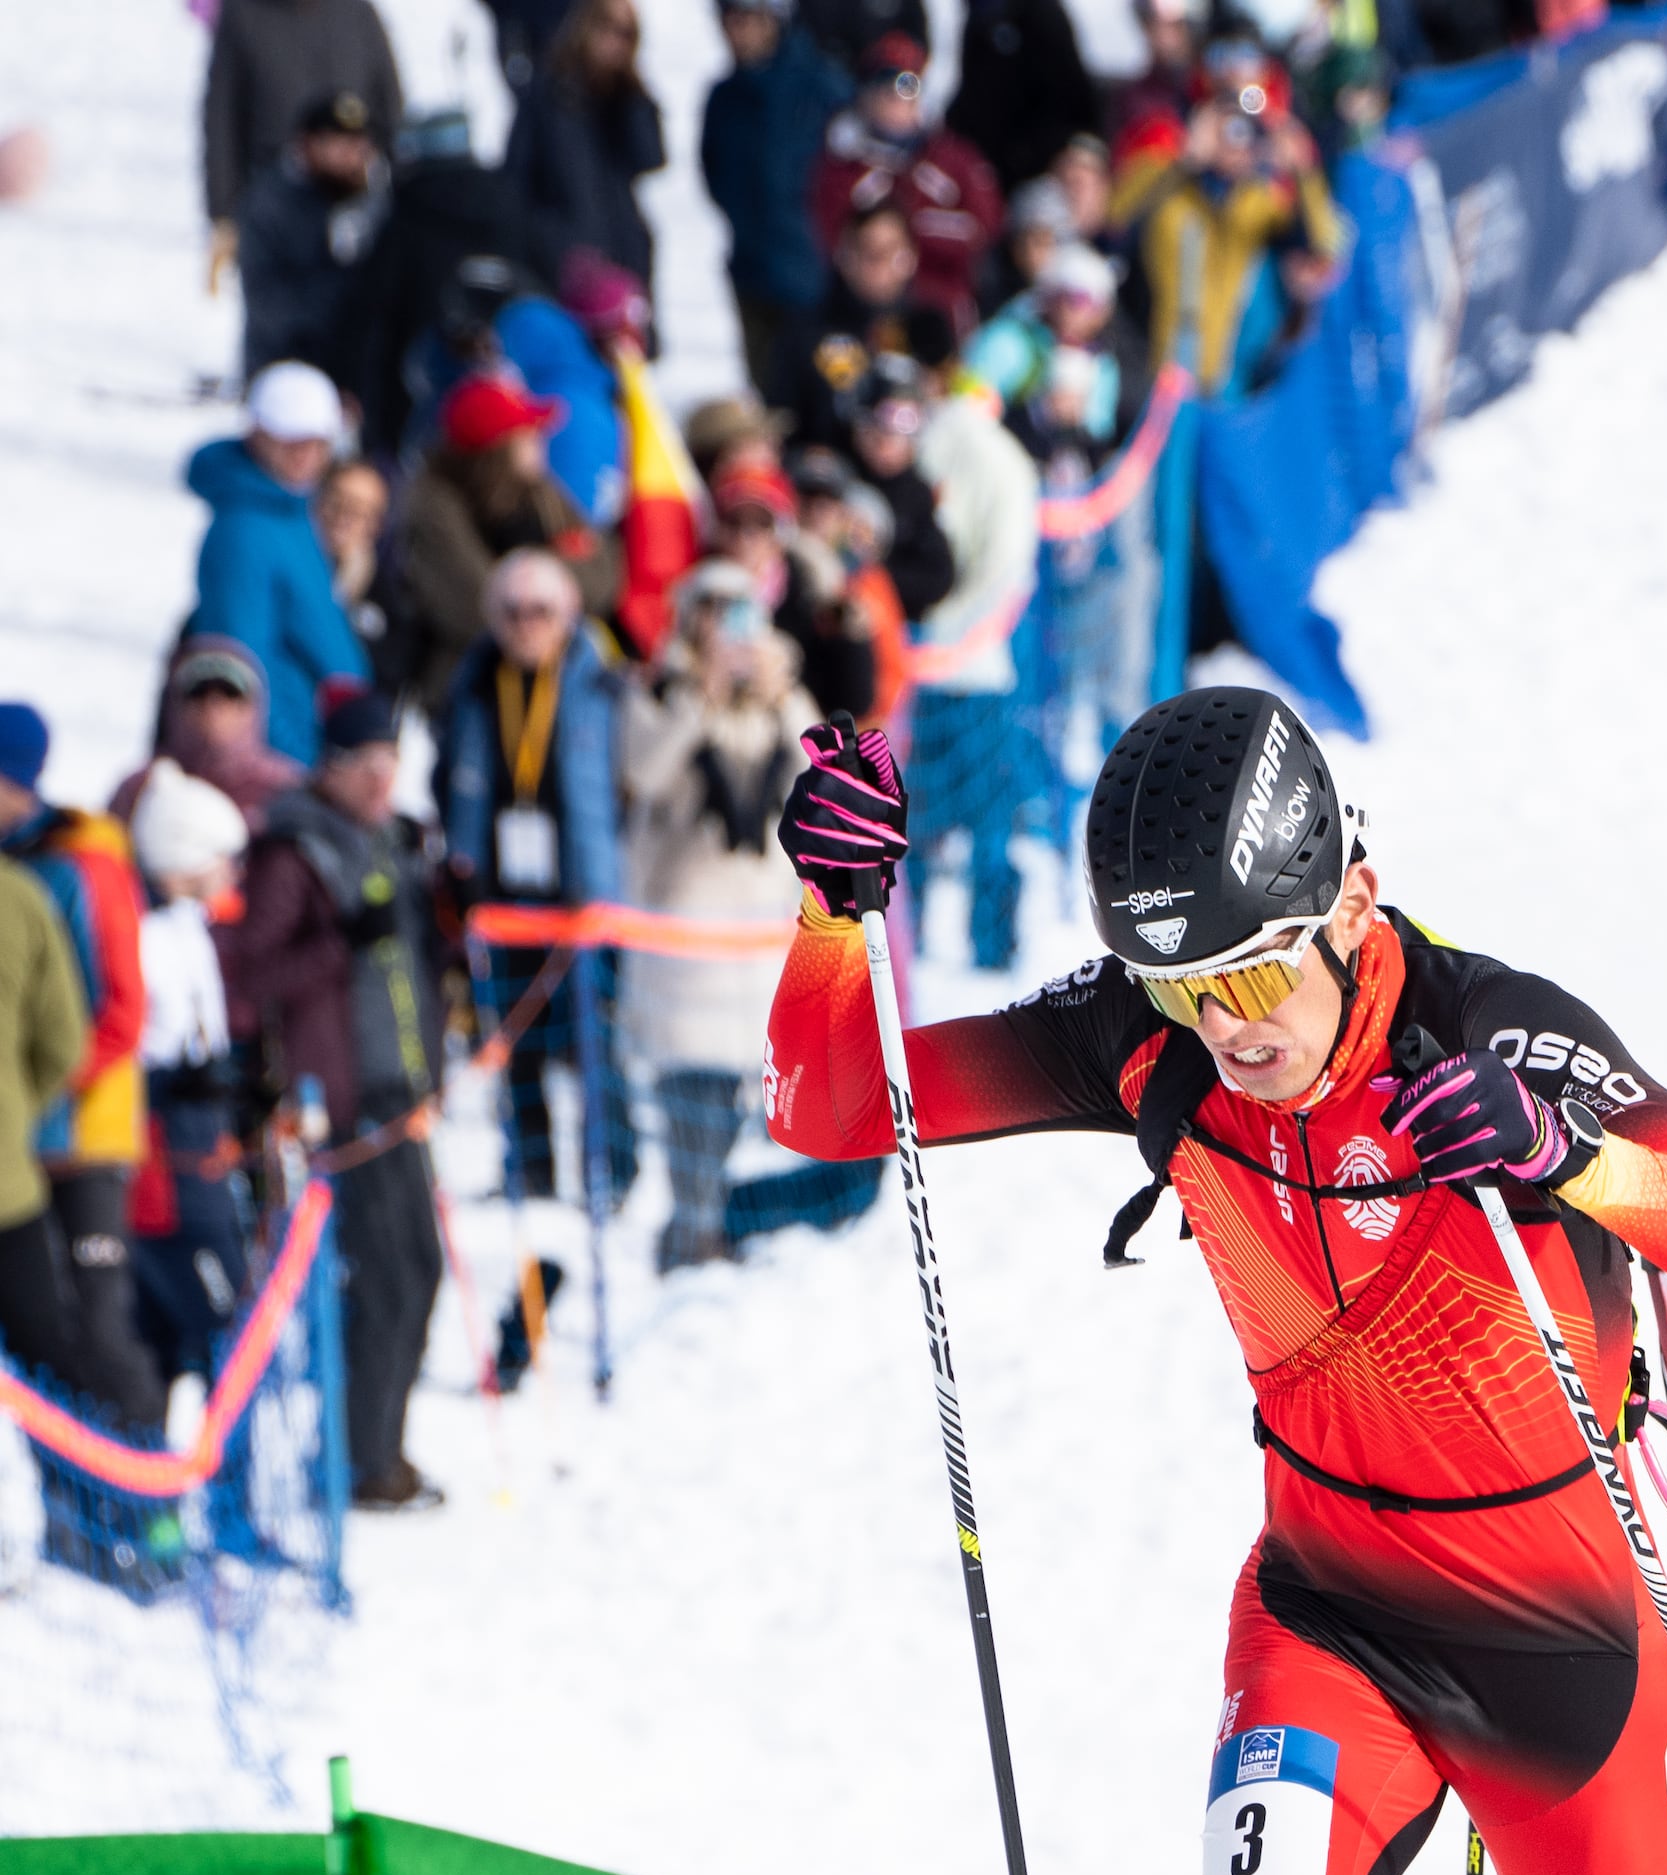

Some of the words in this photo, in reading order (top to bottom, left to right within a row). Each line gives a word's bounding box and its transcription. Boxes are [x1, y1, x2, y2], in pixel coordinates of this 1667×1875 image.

[1229, 710, 1290, 887] DYNAFIT
[1128, 887, 1173, 914] spel
[1401, 1052, 1467, 1107] DYNAFIT
[1243, 1749, 1278, 1765] ISMF
[1261, 1762, 1278, 1771] CUP
